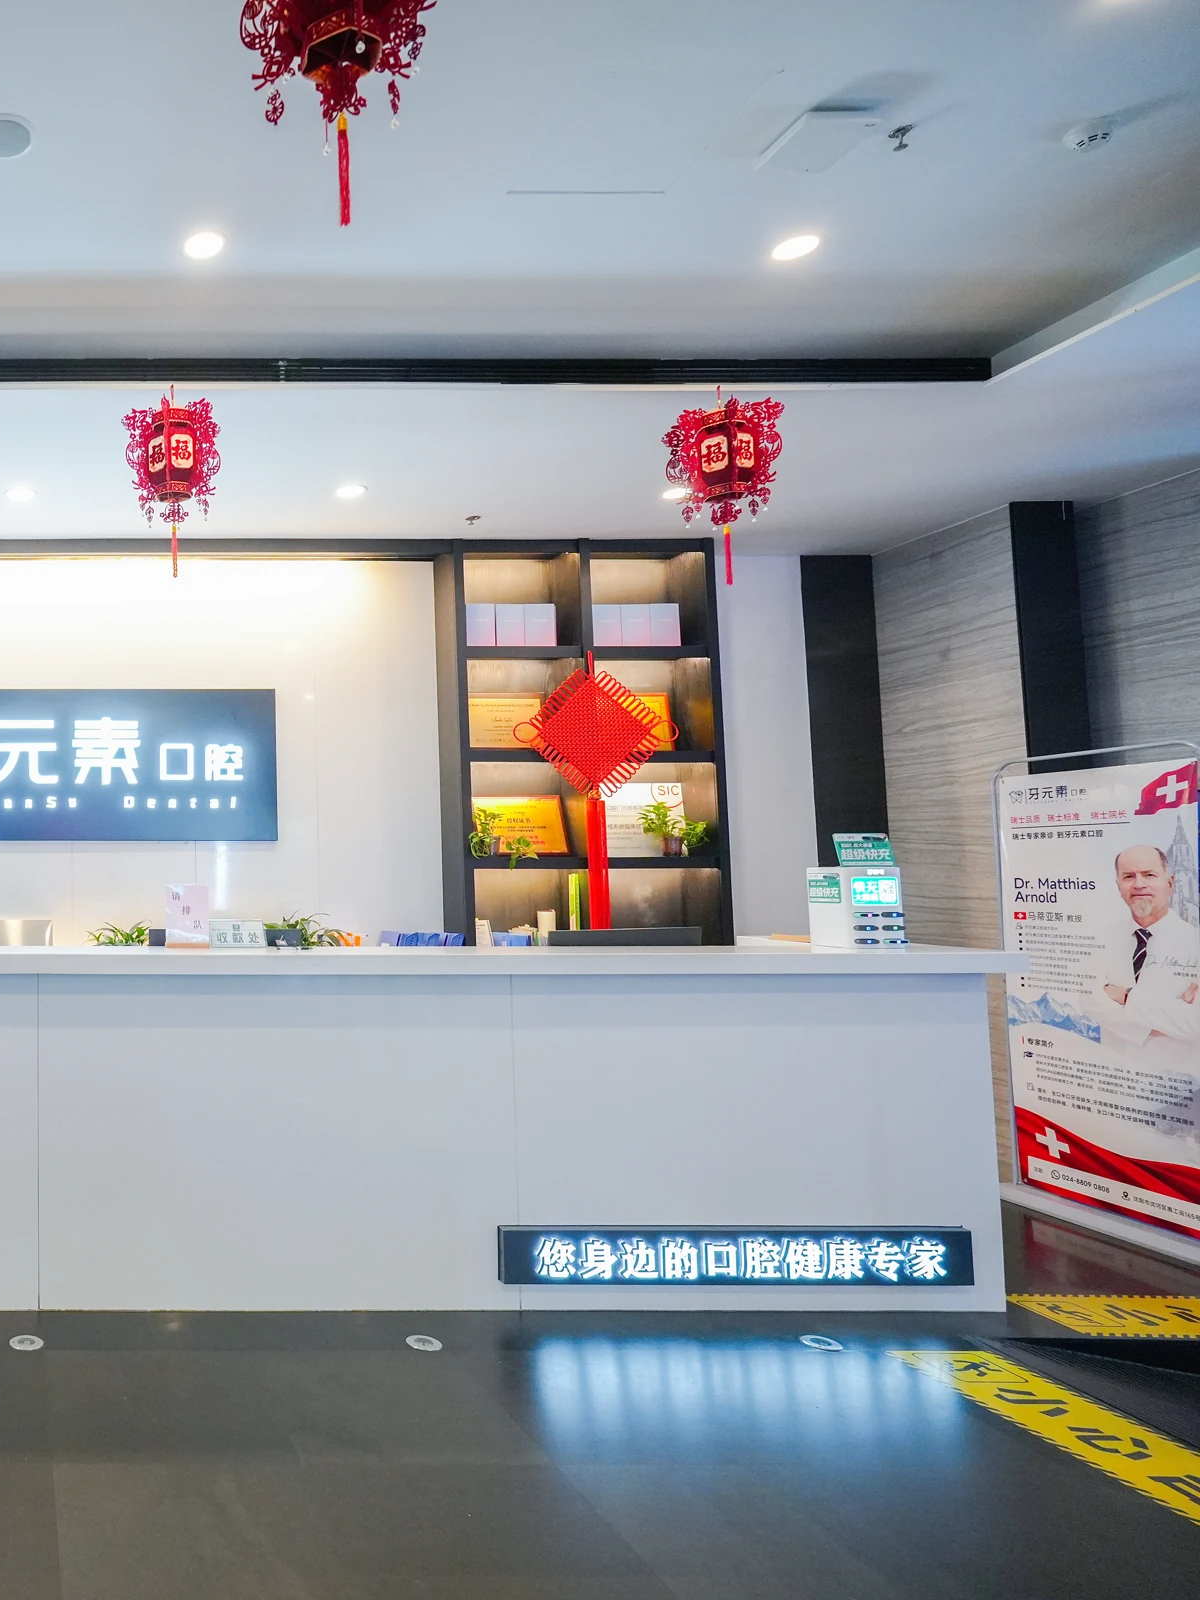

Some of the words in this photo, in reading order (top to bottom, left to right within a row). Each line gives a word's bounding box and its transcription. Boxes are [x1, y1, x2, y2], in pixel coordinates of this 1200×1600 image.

[171, 439, 191, 460] 福
[701, 441, 727, 465] 福
[658, 785, 680, 796] SIC
[841, 848, 892, 860] 超级快充
[1014, 877, 1034, 889] Dr.
[1038, 877, 1096, 890] Matthias
[1014, 891, 1057, 903] Arnold
[216, 932, 260, 944] 收款处
[1027, 1037, 1054, 1048] 专家简介
[1062, 1174, 1092, 1188] 024-8809
[1093, 1183, 1110, 1194] 0808
[534, 1236, 949, 1281] 您身边的口腔健康专家
